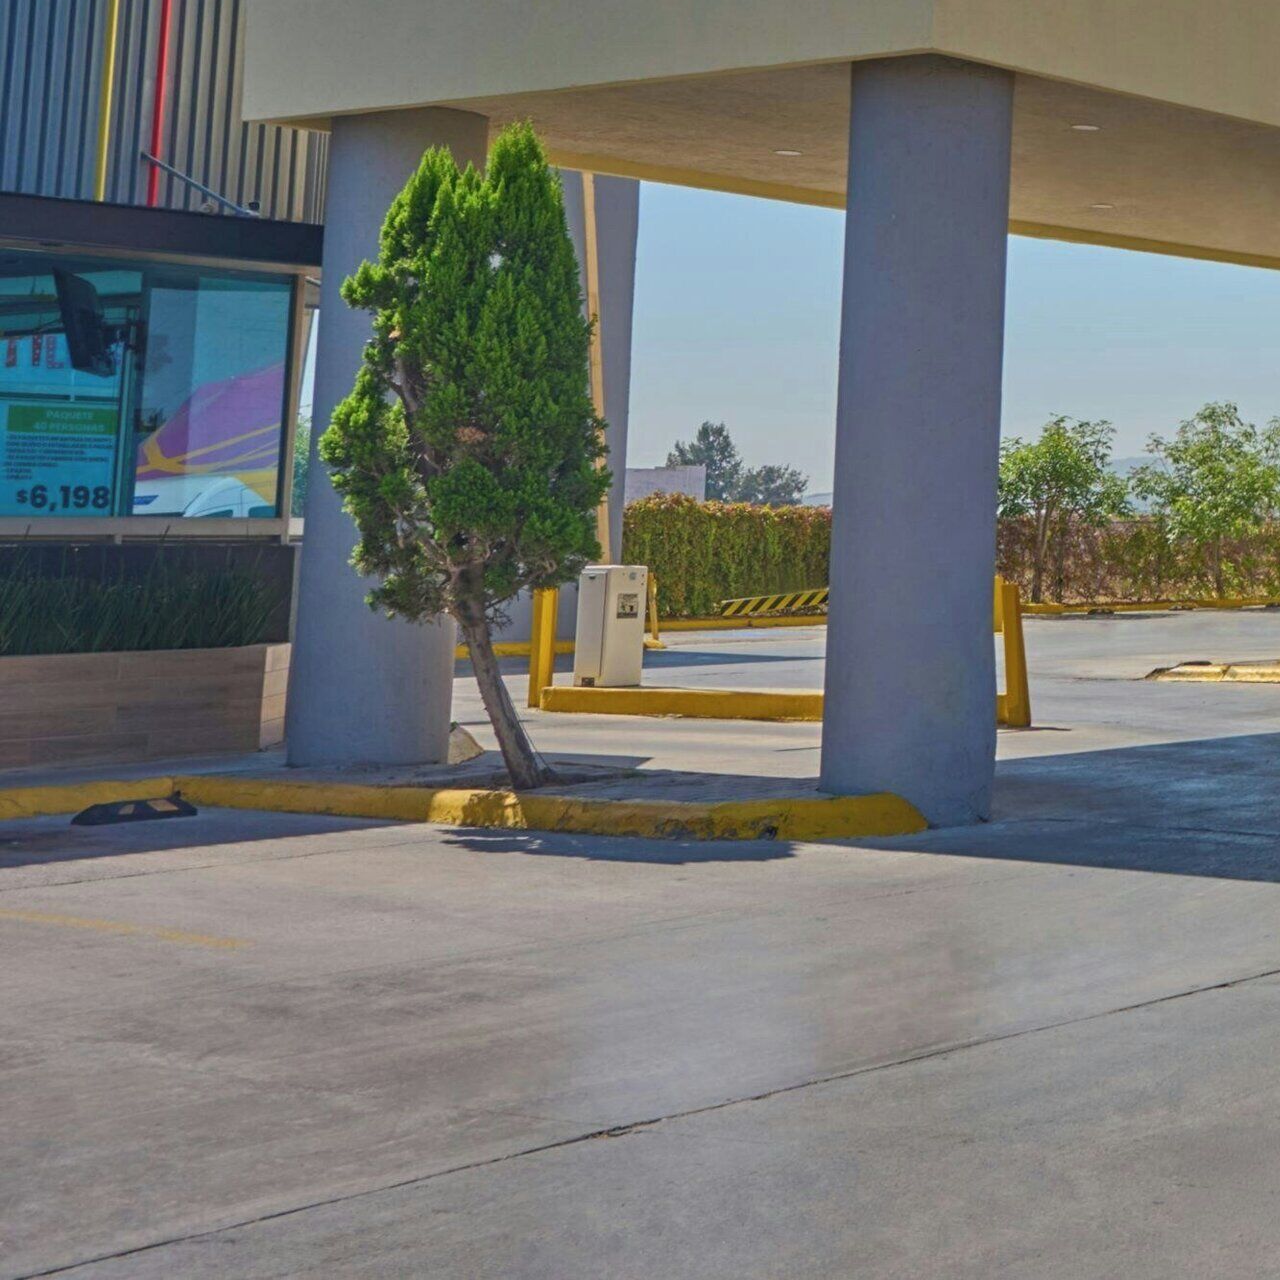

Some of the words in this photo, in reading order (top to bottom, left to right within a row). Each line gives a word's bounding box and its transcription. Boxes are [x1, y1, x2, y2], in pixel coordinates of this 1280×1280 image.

[46, 409, 94, 420] PAQUETE
[32, 422, 48, 431] 40
[50, 422, 105, 432] PERSONAS
[15, 484, 110, 512] $6,198
